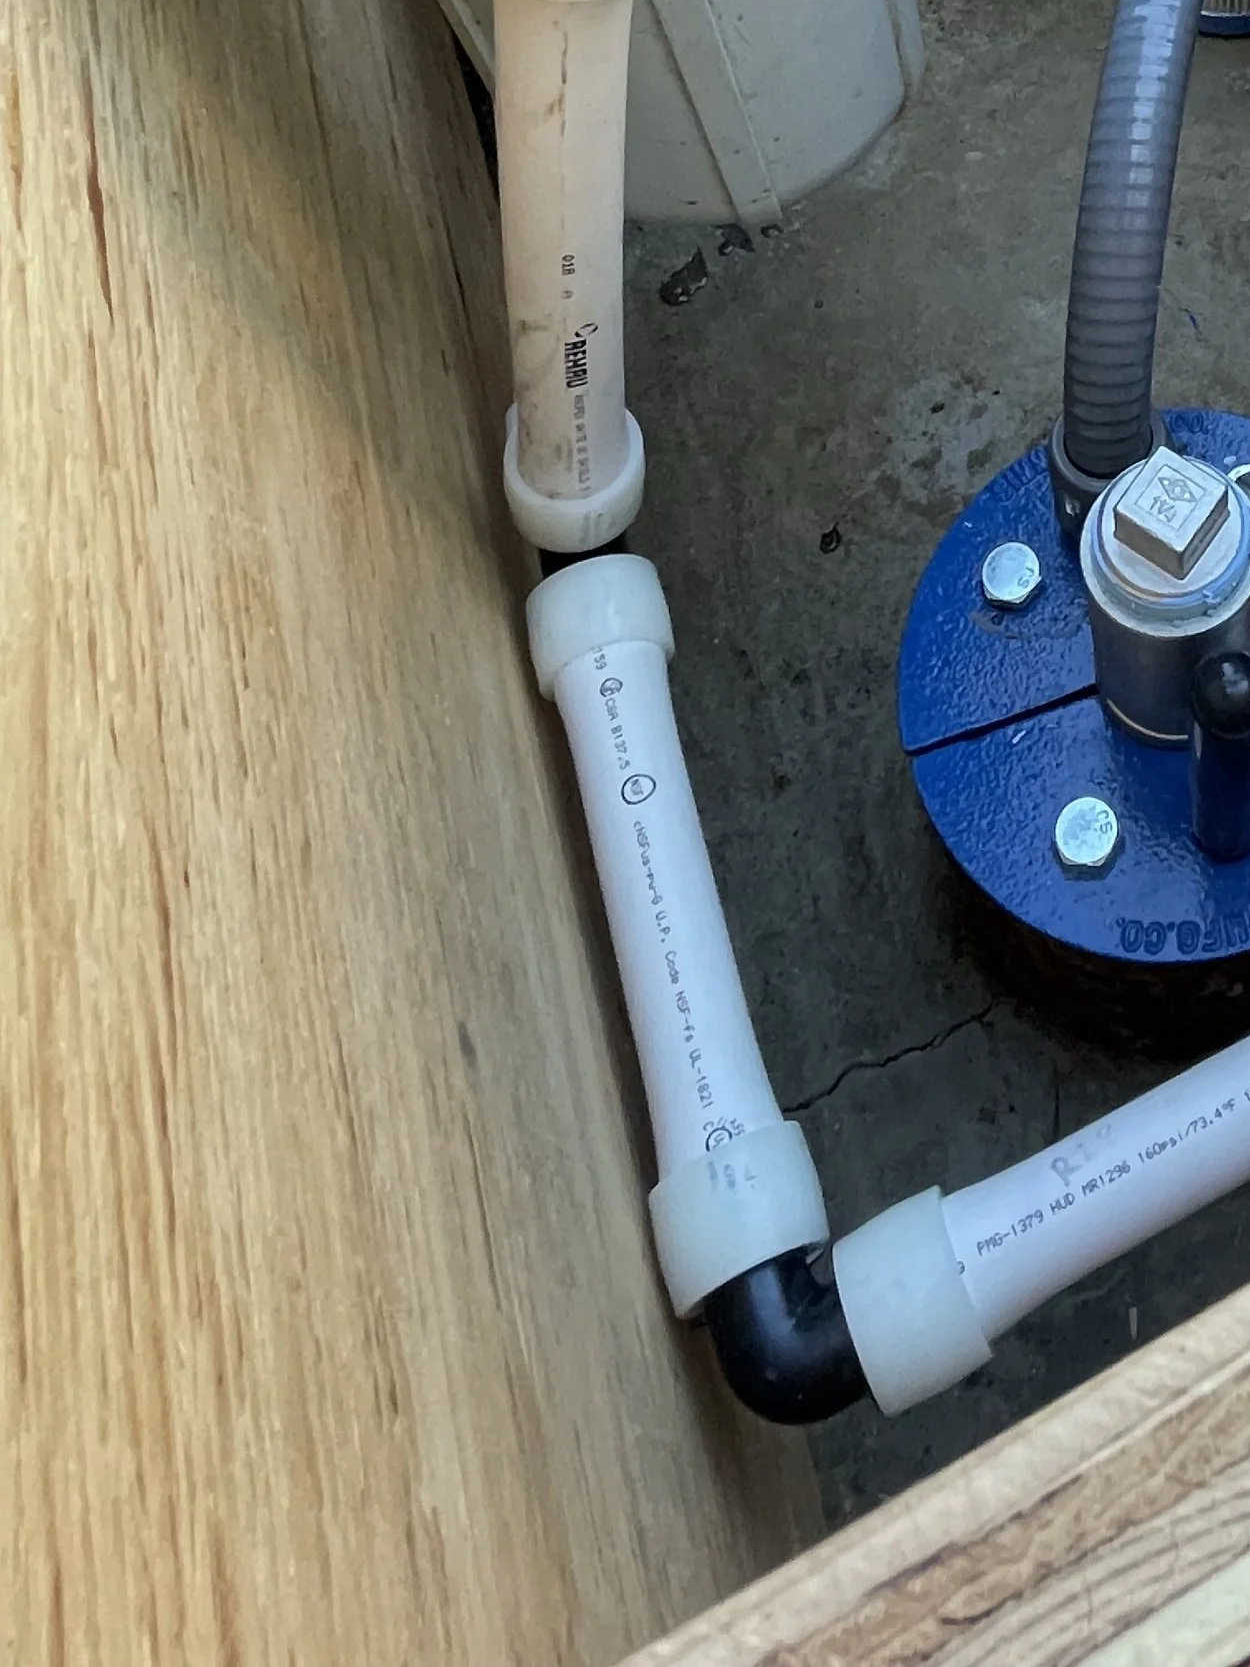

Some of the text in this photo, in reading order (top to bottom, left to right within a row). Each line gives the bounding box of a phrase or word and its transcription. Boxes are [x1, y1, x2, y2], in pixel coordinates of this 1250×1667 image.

[564, 338, 589, 389] REHAU
[973, 1207, 1047, 1257] PMG-1379
[1046, 1189, 1078, 1215] HUD
[1078, 1158, 1133, 1197] MR1296
